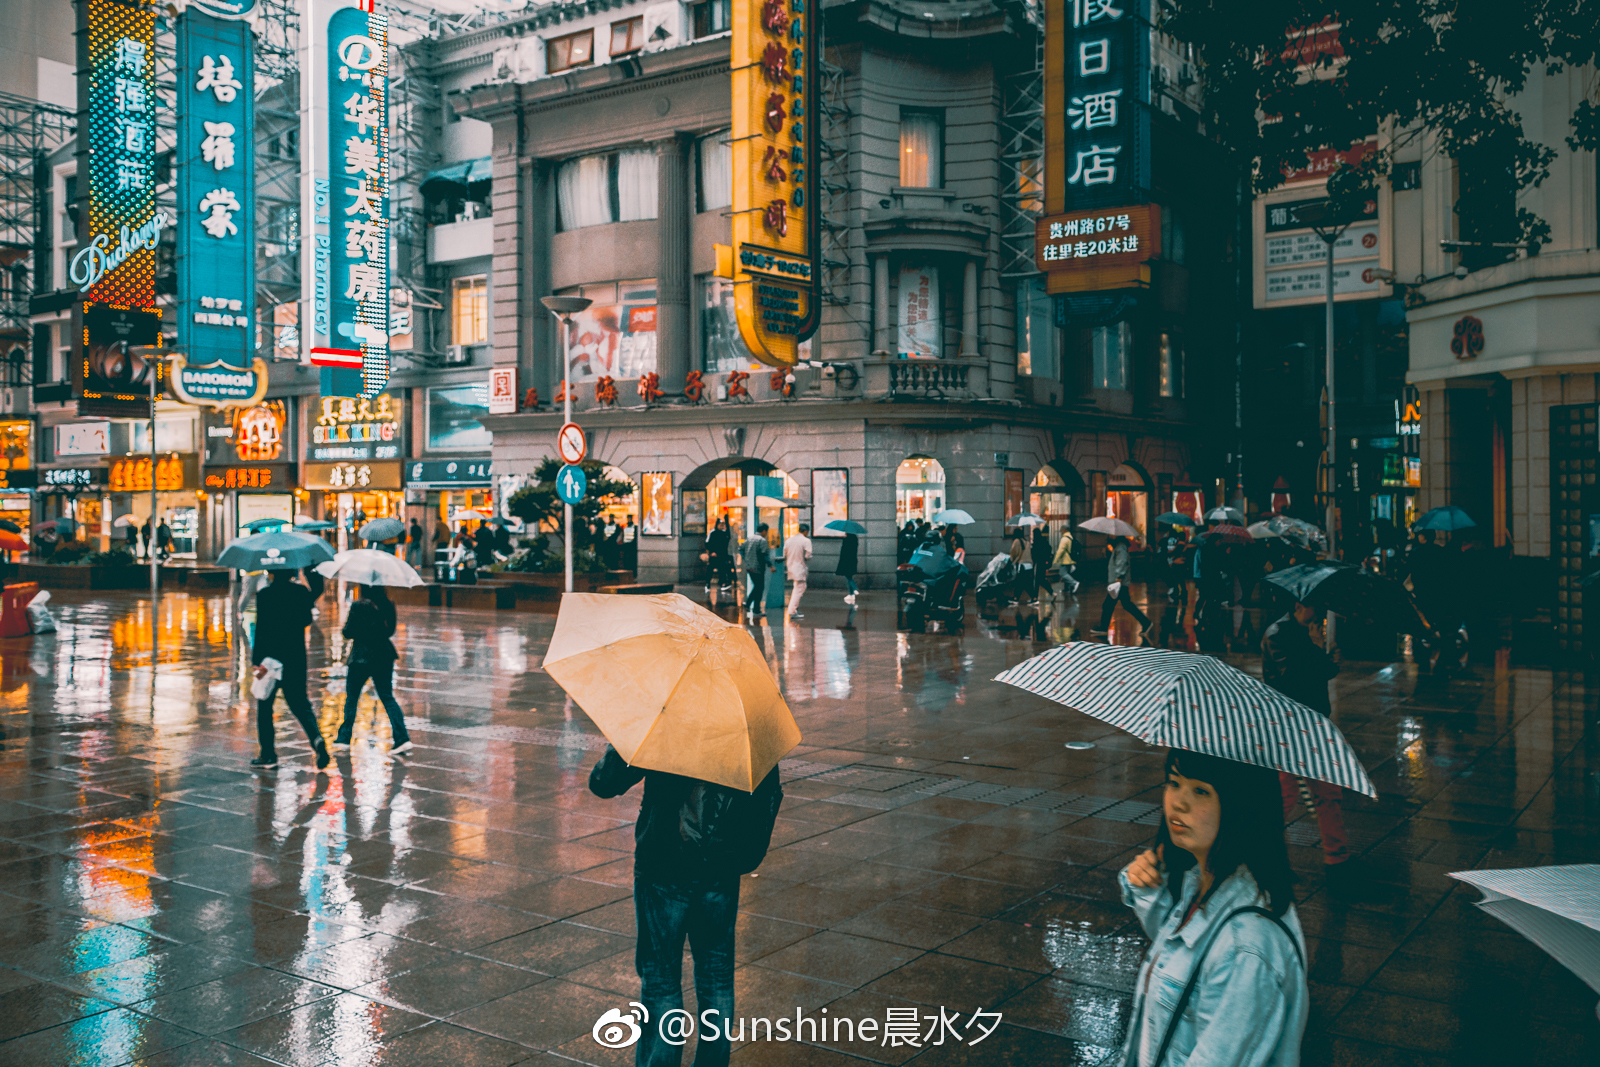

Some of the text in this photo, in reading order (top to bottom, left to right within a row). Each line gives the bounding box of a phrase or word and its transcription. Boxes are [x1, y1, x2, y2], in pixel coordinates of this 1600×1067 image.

[1067, 0, 1124, 186] 假日酒店
[343, 92, 382, 301] 华美大药房
[1049, 214, 1131, 239] 贵州路67号
[70, 212, 168, 293] Duchamp
[314, 234, 331, 336] Pharmacy
[1043, 235, 1139, 261] 往里走20米进
[313, 423, 394, 443] SILK KING
